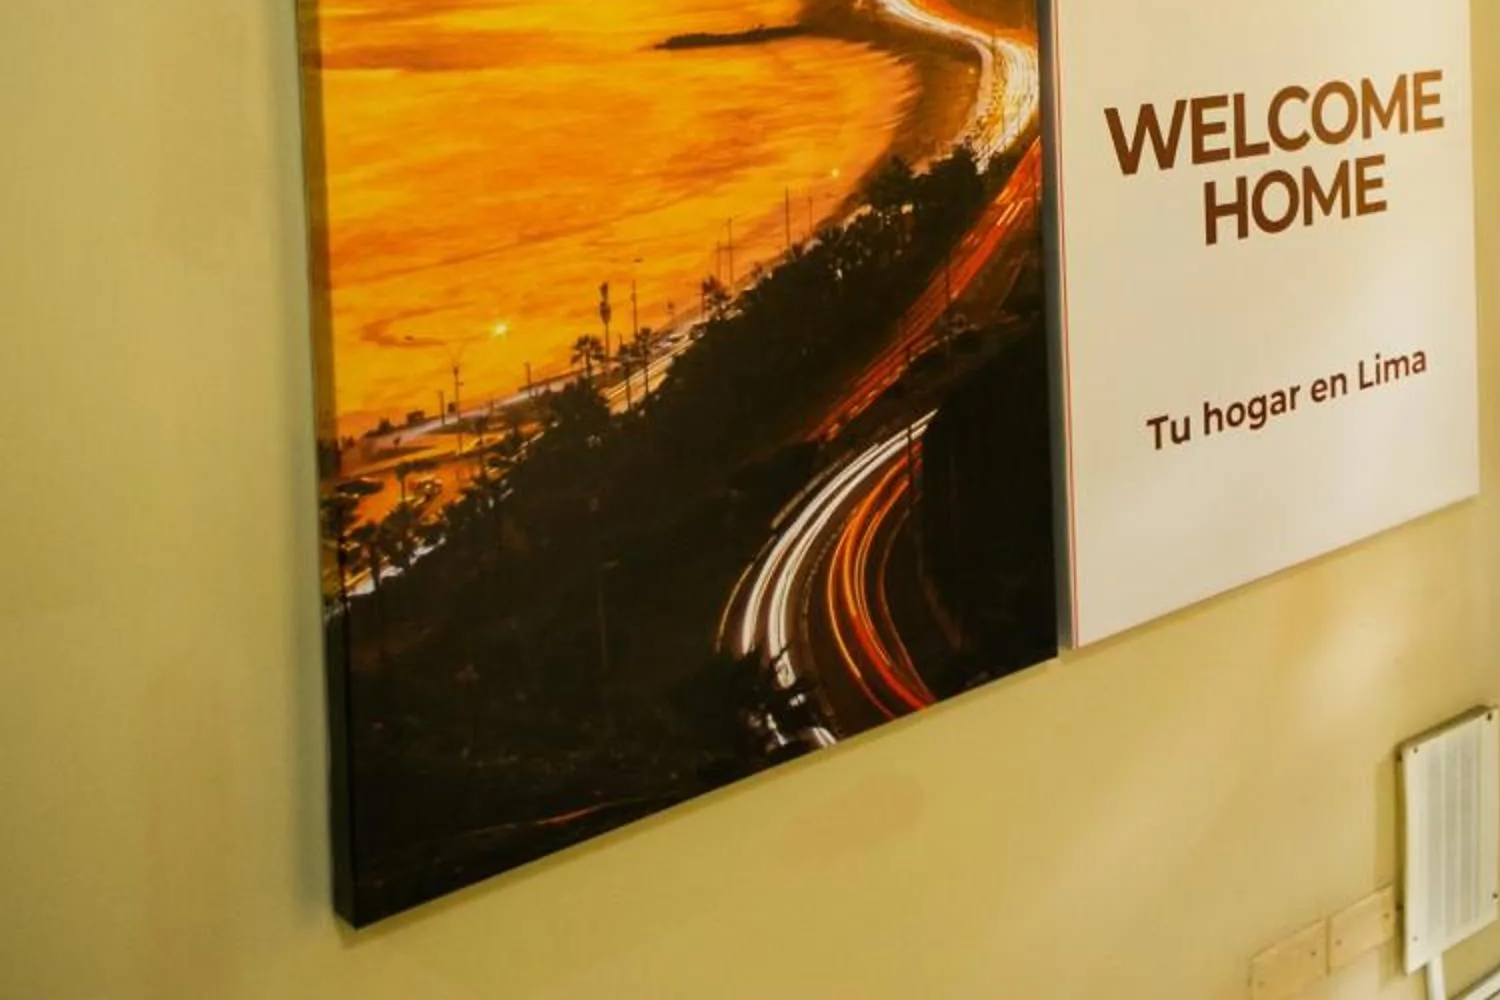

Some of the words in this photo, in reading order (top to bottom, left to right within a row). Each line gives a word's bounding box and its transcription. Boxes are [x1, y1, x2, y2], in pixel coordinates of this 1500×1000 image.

[1104, 69, 1444, 176] WELCOME
[1204, 154, 1387, 245] HOME
[1146, 415, 1191, 450] Tu
[1203, 384, 1301, 435] hogar
[1310, 372, 1348, 403] en
[1358, 350, 1427, 390] Lima
